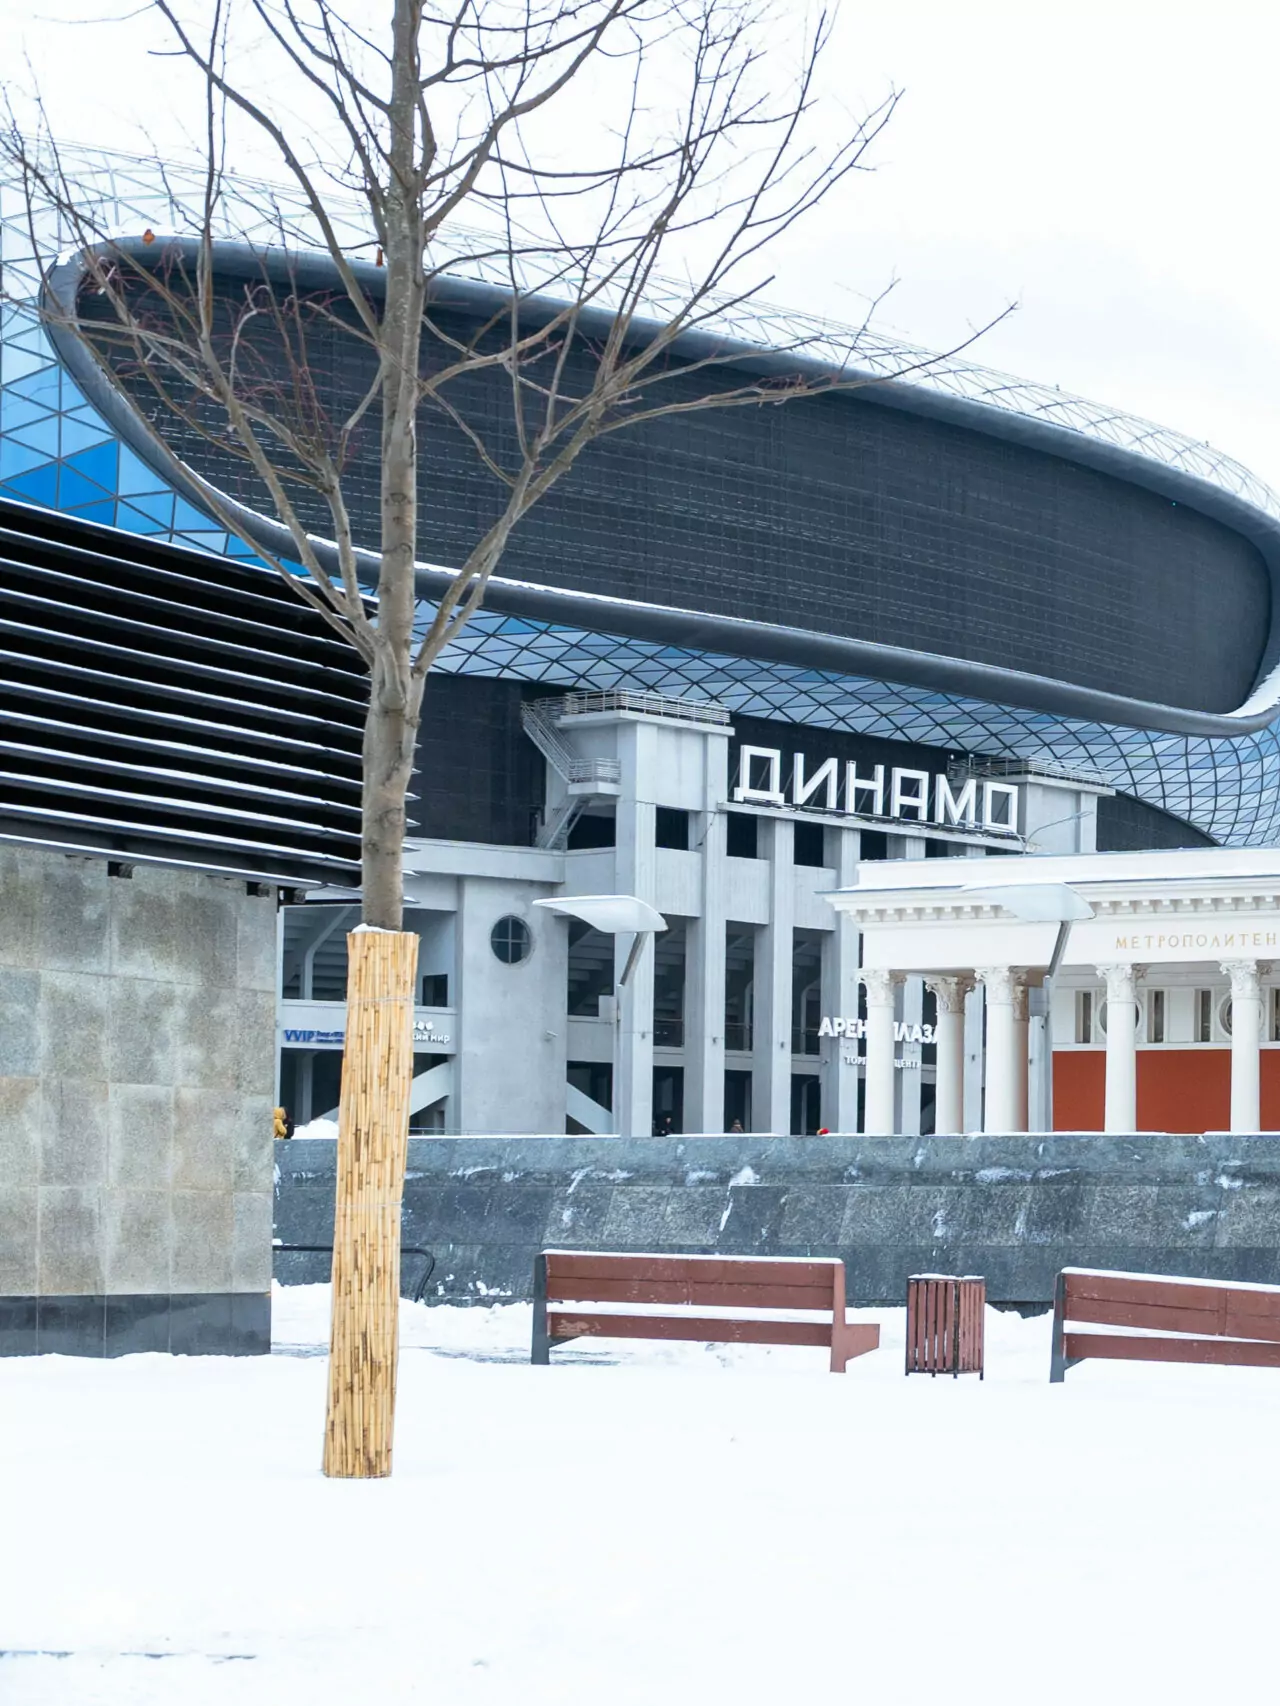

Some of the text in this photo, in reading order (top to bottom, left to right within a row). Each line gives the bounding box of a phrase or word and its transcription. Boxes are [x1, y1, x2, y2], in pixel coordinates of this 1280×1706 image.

[734, 745, 1018, 832] ДИНАМО
[1116, 932, 1277, 949] МЕТРОПОЛИТЕН
[818, 1016, 867, 1039] АРЕН
